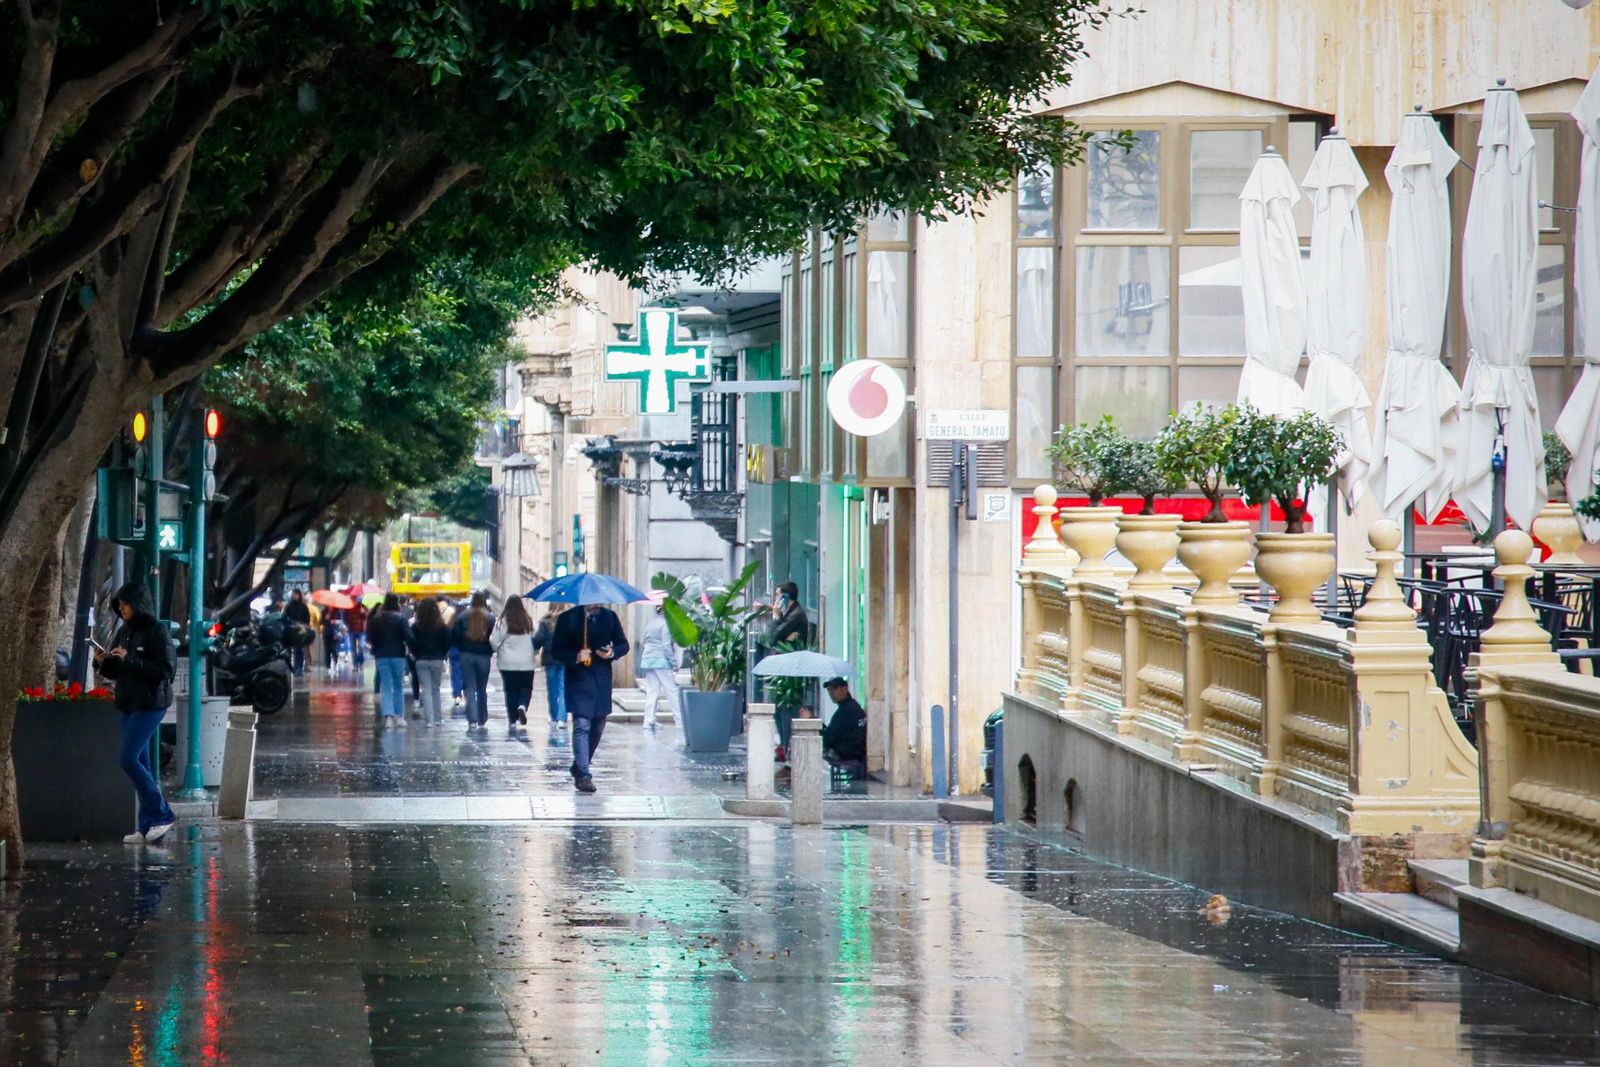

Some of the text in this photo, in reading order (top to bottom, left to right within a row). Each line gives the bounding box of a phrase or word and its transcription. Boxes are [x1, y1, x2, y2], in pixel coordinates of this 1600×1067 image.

[959, 413, 988, 422] CALLE
[929, 426, 1006, 437] GENERAL TAMAYO
